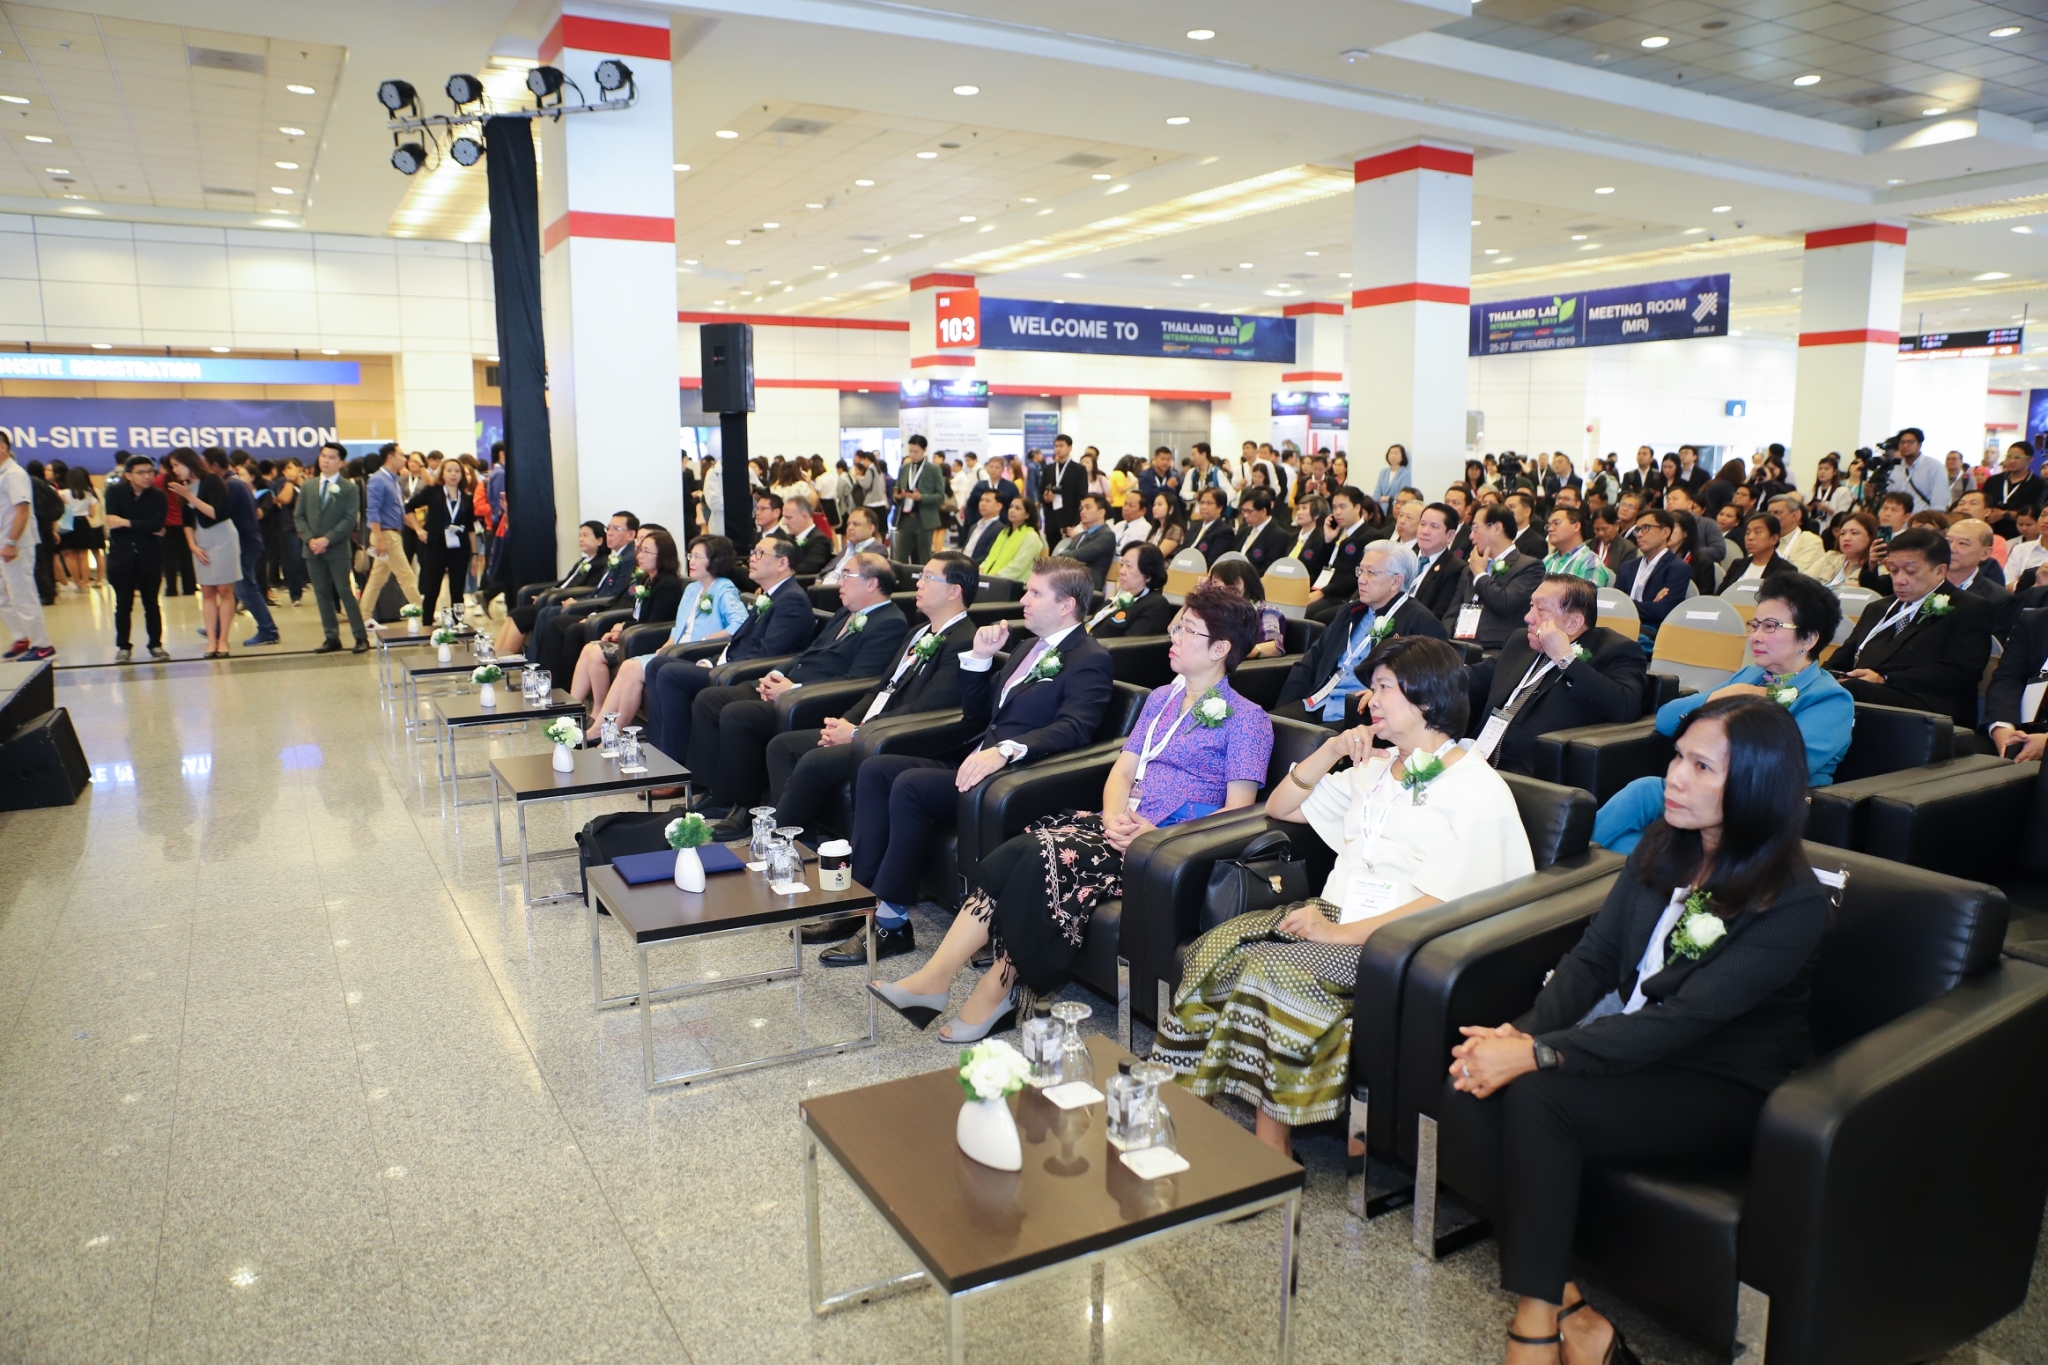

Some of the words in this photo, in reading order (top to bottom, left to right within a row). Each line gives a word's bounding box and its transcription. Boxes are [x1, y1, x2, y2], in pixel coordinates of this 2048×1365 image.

[1488, 308, 1536, 322] THAILAND
[1538, 305, 1559, 318] LAB
[1588, 302, 1643, 321] MEETING
[1646, 297, 1687, 315] ROOM
[939, 316, 975, 342] 103
[1009, 314, 1108, 339] WELCOME
[1113, 321, 1139, 341] TO
[1161, 321, 1215, 334] THAILAND
[1217, 325, 1238, 336] LAB
[1621, 317, 1650, 336] (MR)
[1510, 337, 1556, 352] SEPTEMBER
[1556, 335, 1576, 347] 2019
[69, 359, 202, 380] REGISTRATION
[128, 426, 337, 448] REGISTRATION
